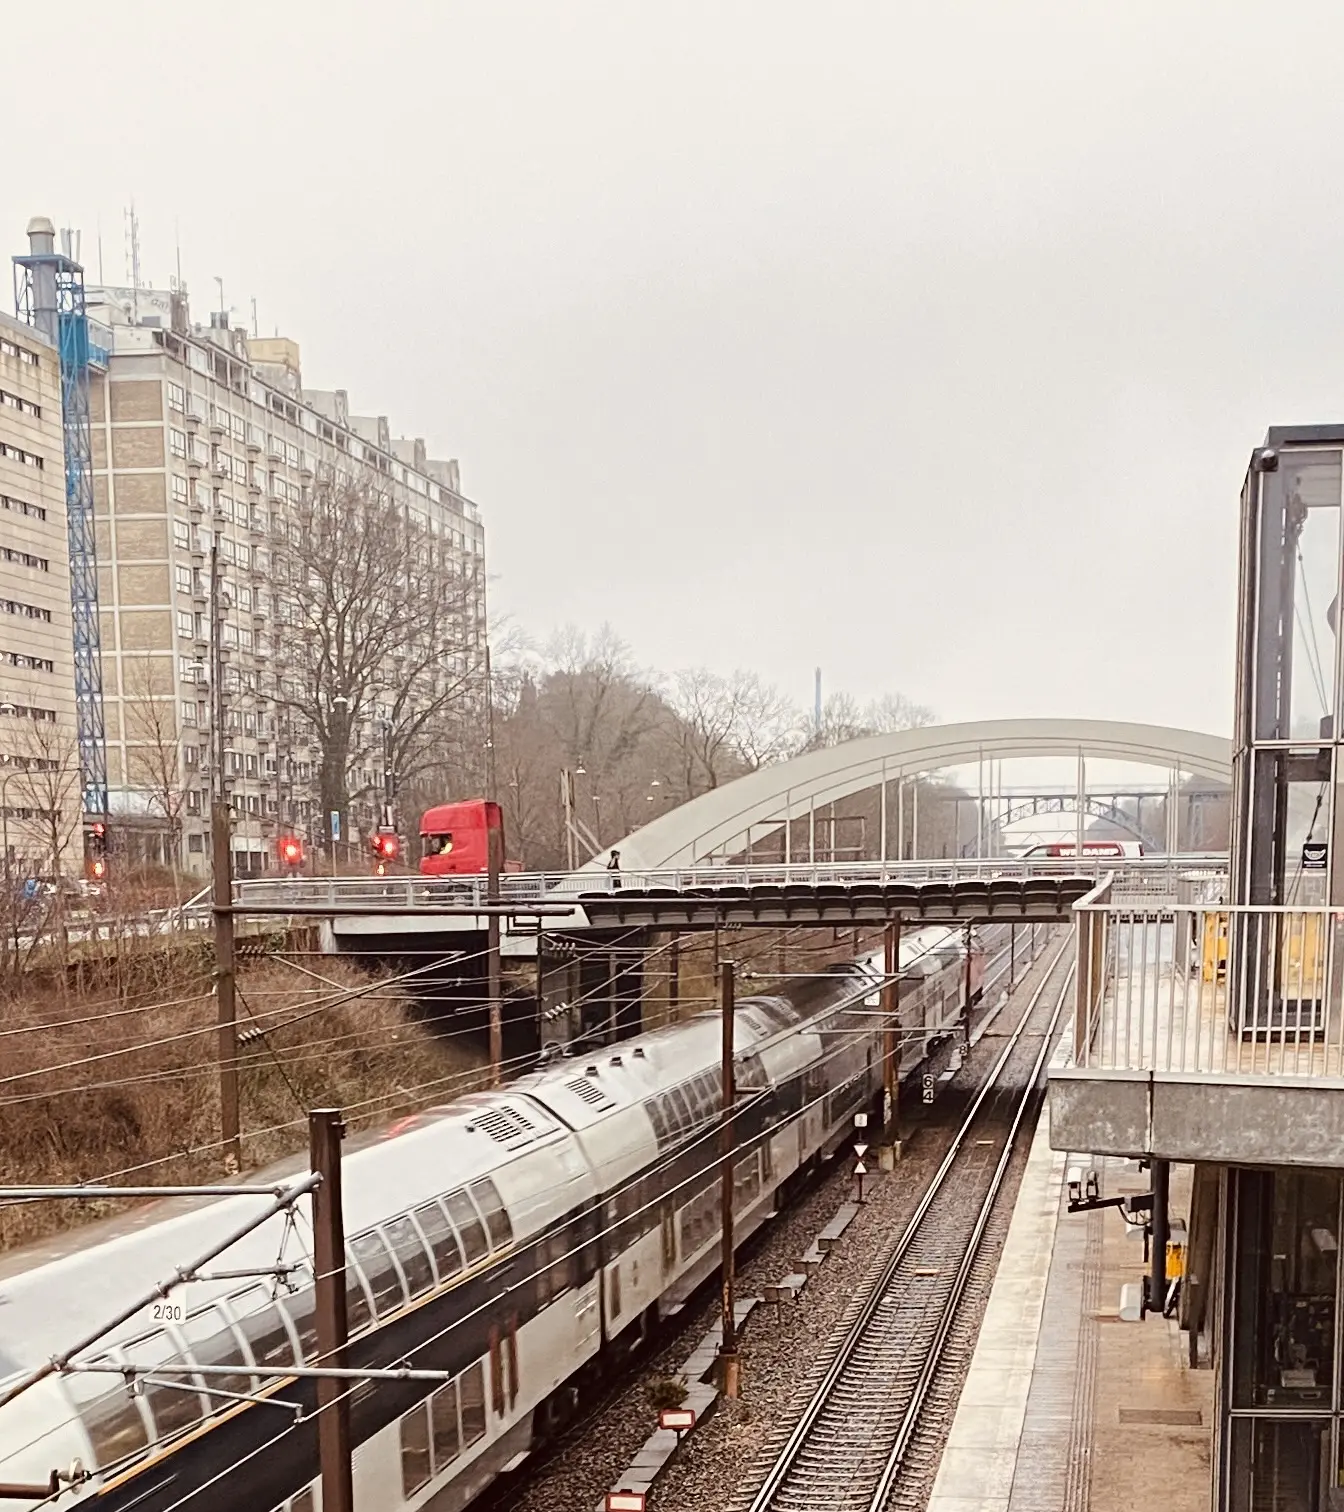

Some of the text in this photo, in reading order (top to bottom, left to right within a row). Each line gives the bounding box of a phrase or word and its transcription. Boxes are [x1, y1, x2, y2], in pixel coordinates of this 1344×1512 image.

[923, 1075, 933, 1088] 6
[923, 1091, 934, 1102] 4
[153, 1304, 181, 1321] 2/30
